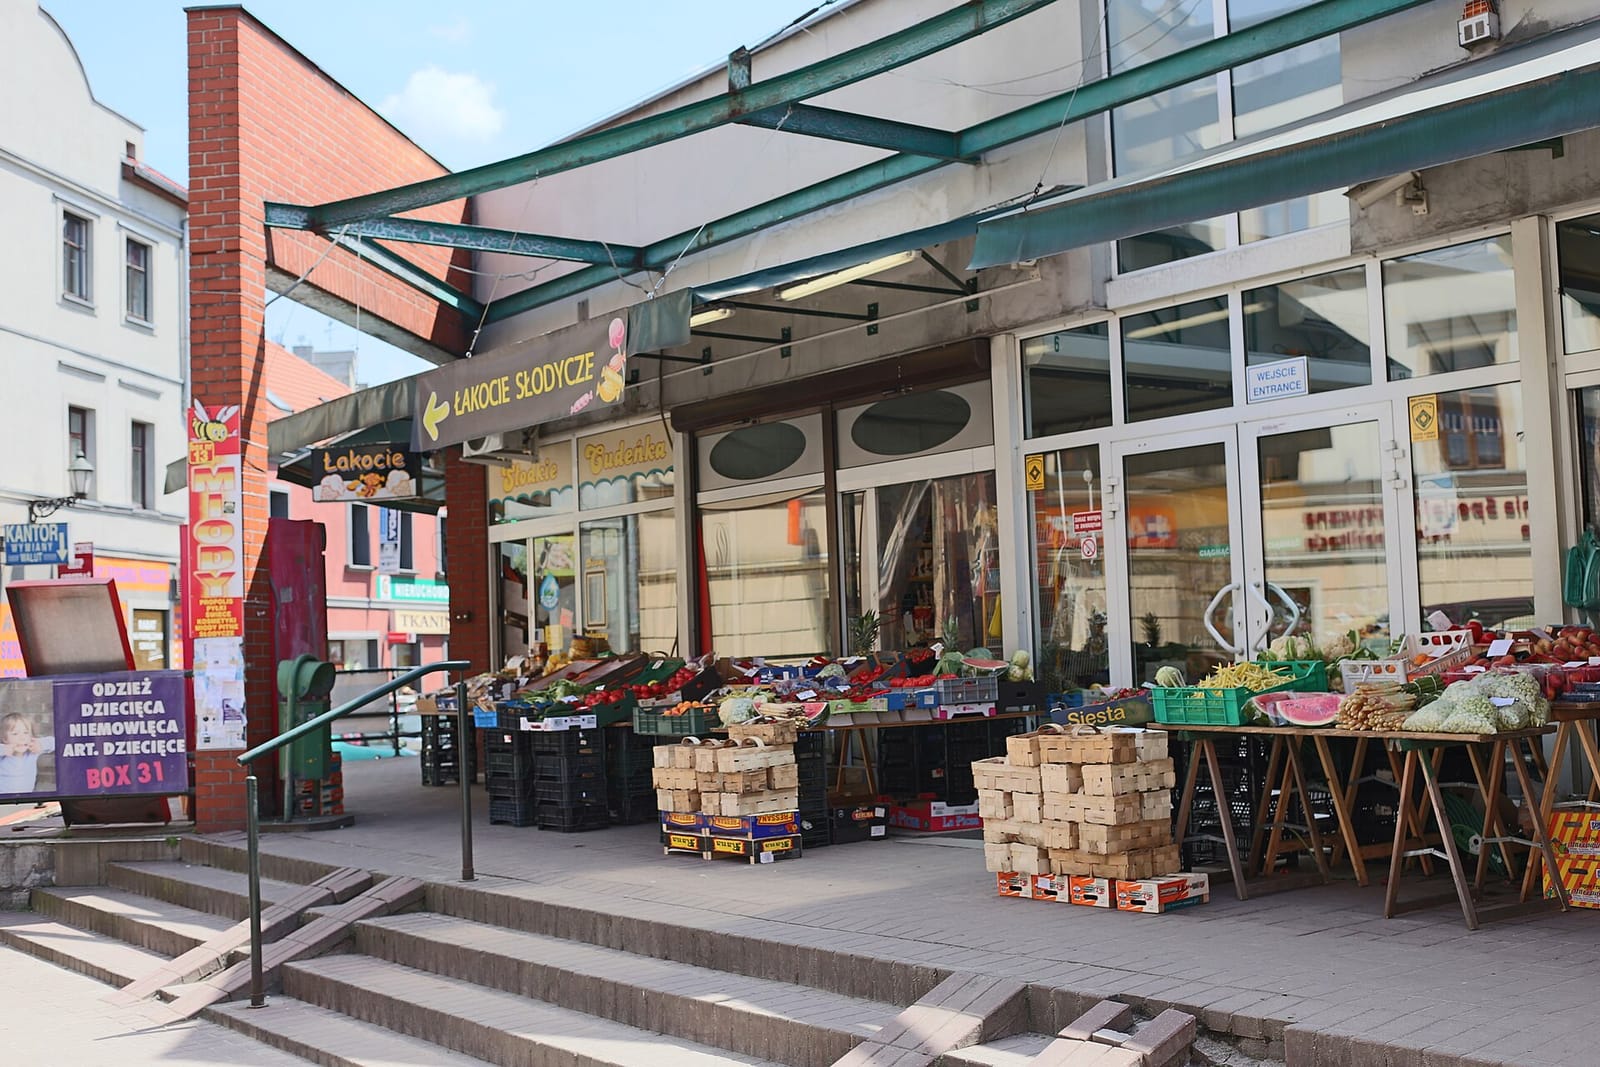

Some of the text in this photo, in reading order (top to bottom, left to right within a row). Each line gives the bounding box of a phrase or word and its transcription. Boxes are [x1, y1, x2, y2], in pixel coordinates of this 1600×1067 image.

[1257, 367, 1296, 381] WEJŚCIE
[454, 351, 594, 416] ŁAKOCIE SŁODYCZE
[1253, 381, 1302, 397] ENTRANCE
[323, 448, 406, 473] Łakocie
[6, 525, 58, 542] KANTOR
[192, 465, 235, 597] MIODY
[92, 677, 152, 696] ODZIEŻ
[81, 700, 165, 718] DZIECIĘCA
[1068, 706, 1126, 724] Siesta
[69, 720, 178, 737] NIEMOWLĘCA
[63, 739, 185, 757] ART. DZIECIĘCE
[86, 761, 164, 789] BOX 31
